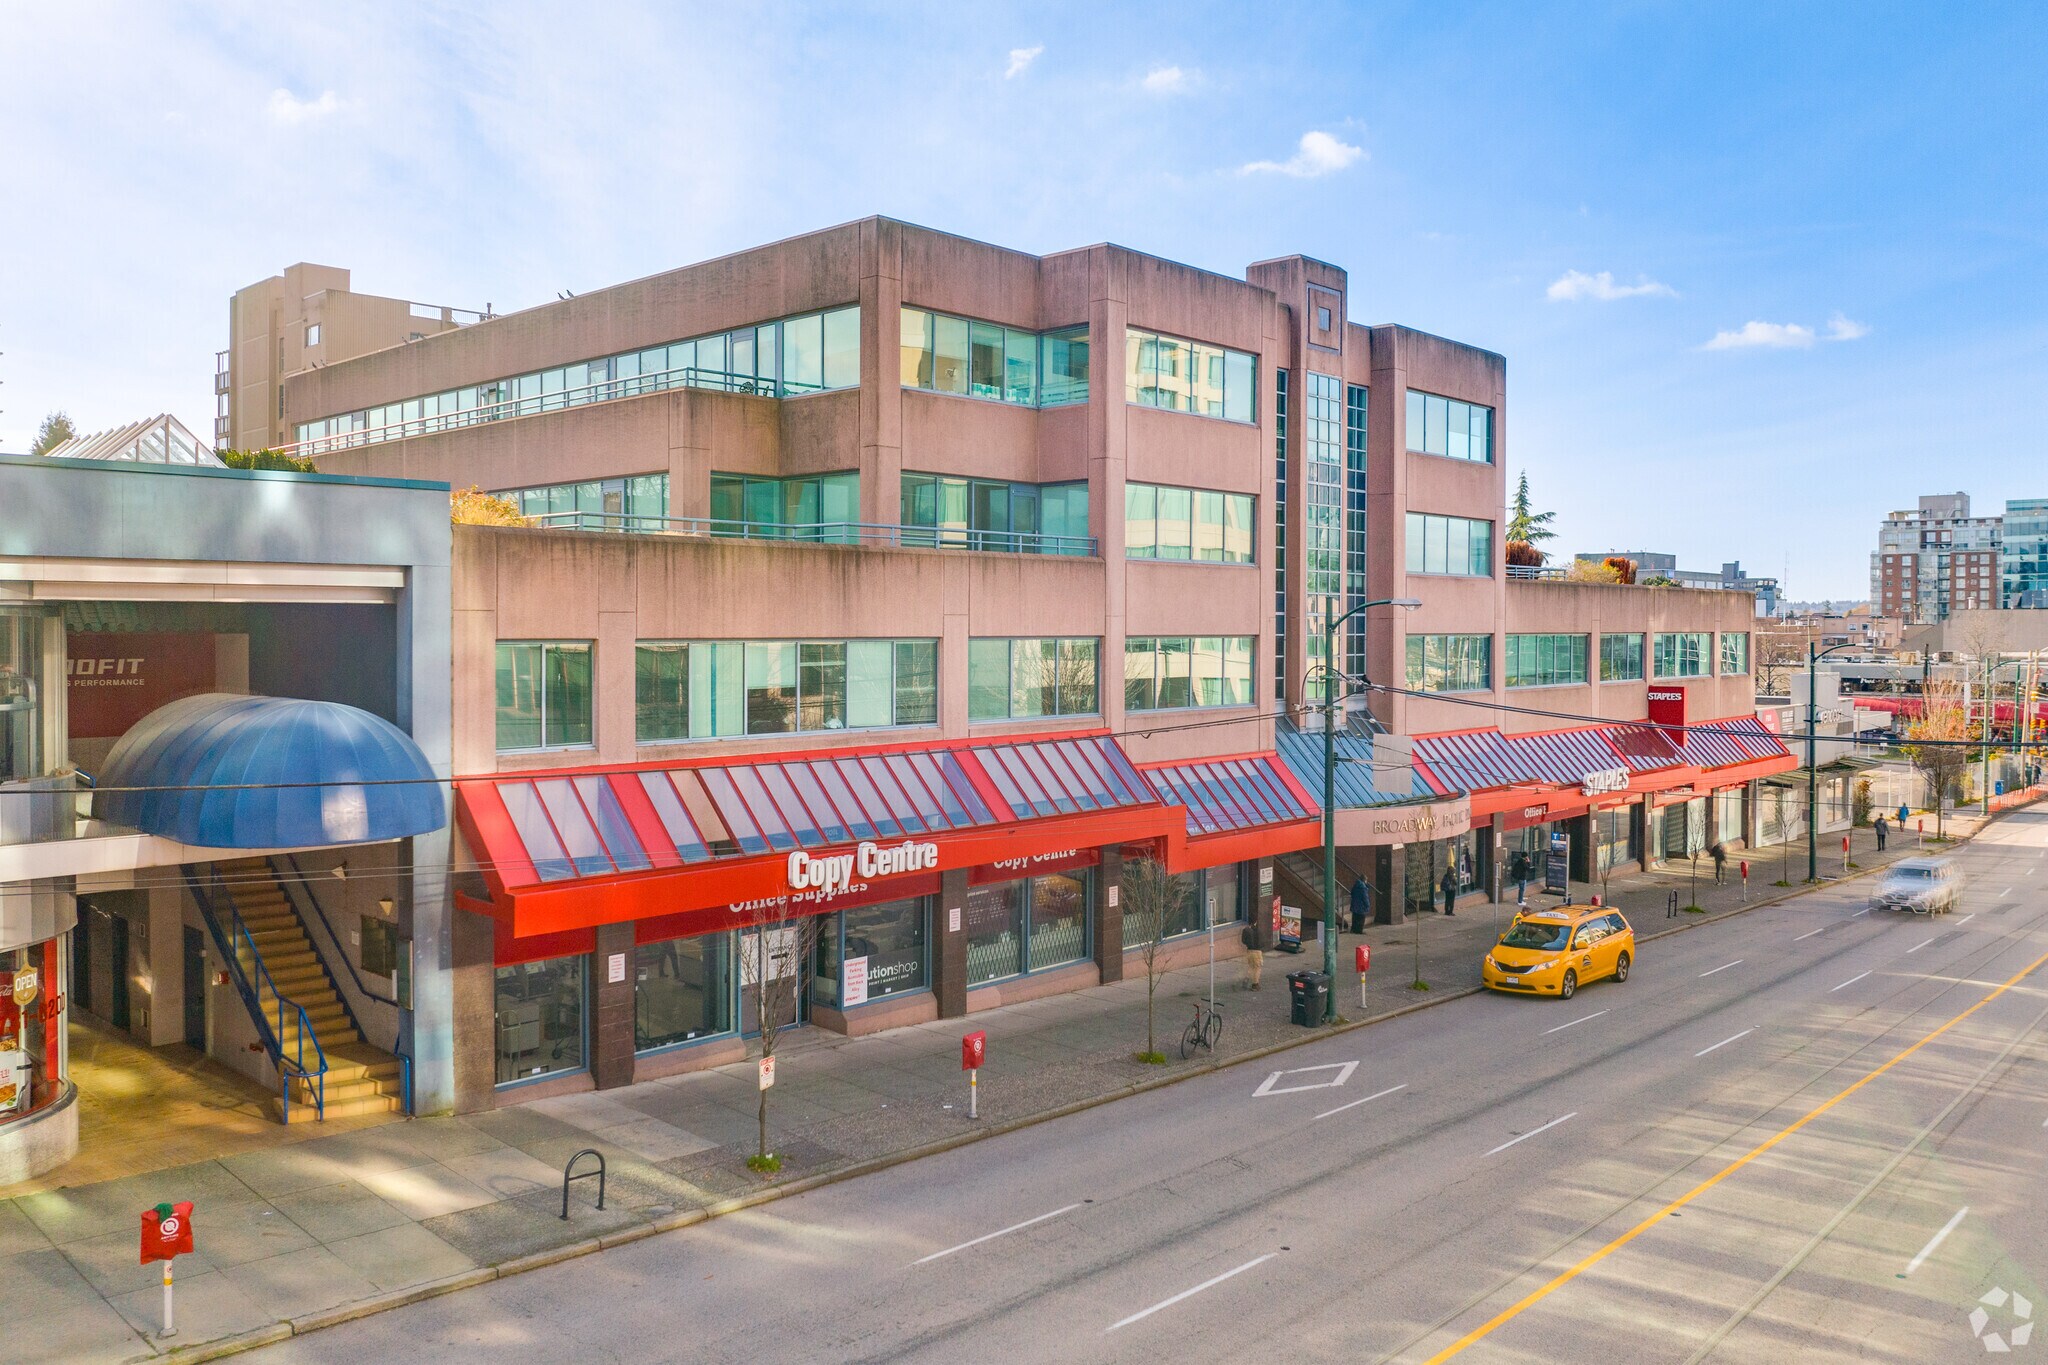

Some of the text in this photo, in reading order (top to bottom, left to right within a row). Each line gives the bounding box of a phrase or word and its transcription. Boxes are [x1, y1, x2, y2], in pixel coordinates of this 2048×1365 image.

[74, 679, 144, 687] PERFORMANCE
[1648, 692, 1682, 700] STAPLES
[1583, 767, 1630, 797] STAPLES
[1524, 806, 1542, 818] Office
[1372, 816, 1438, 834] BROADWAY
[788, 840, 938, 893] Copy Centre
[15, 973, 37, 991] OPEN
